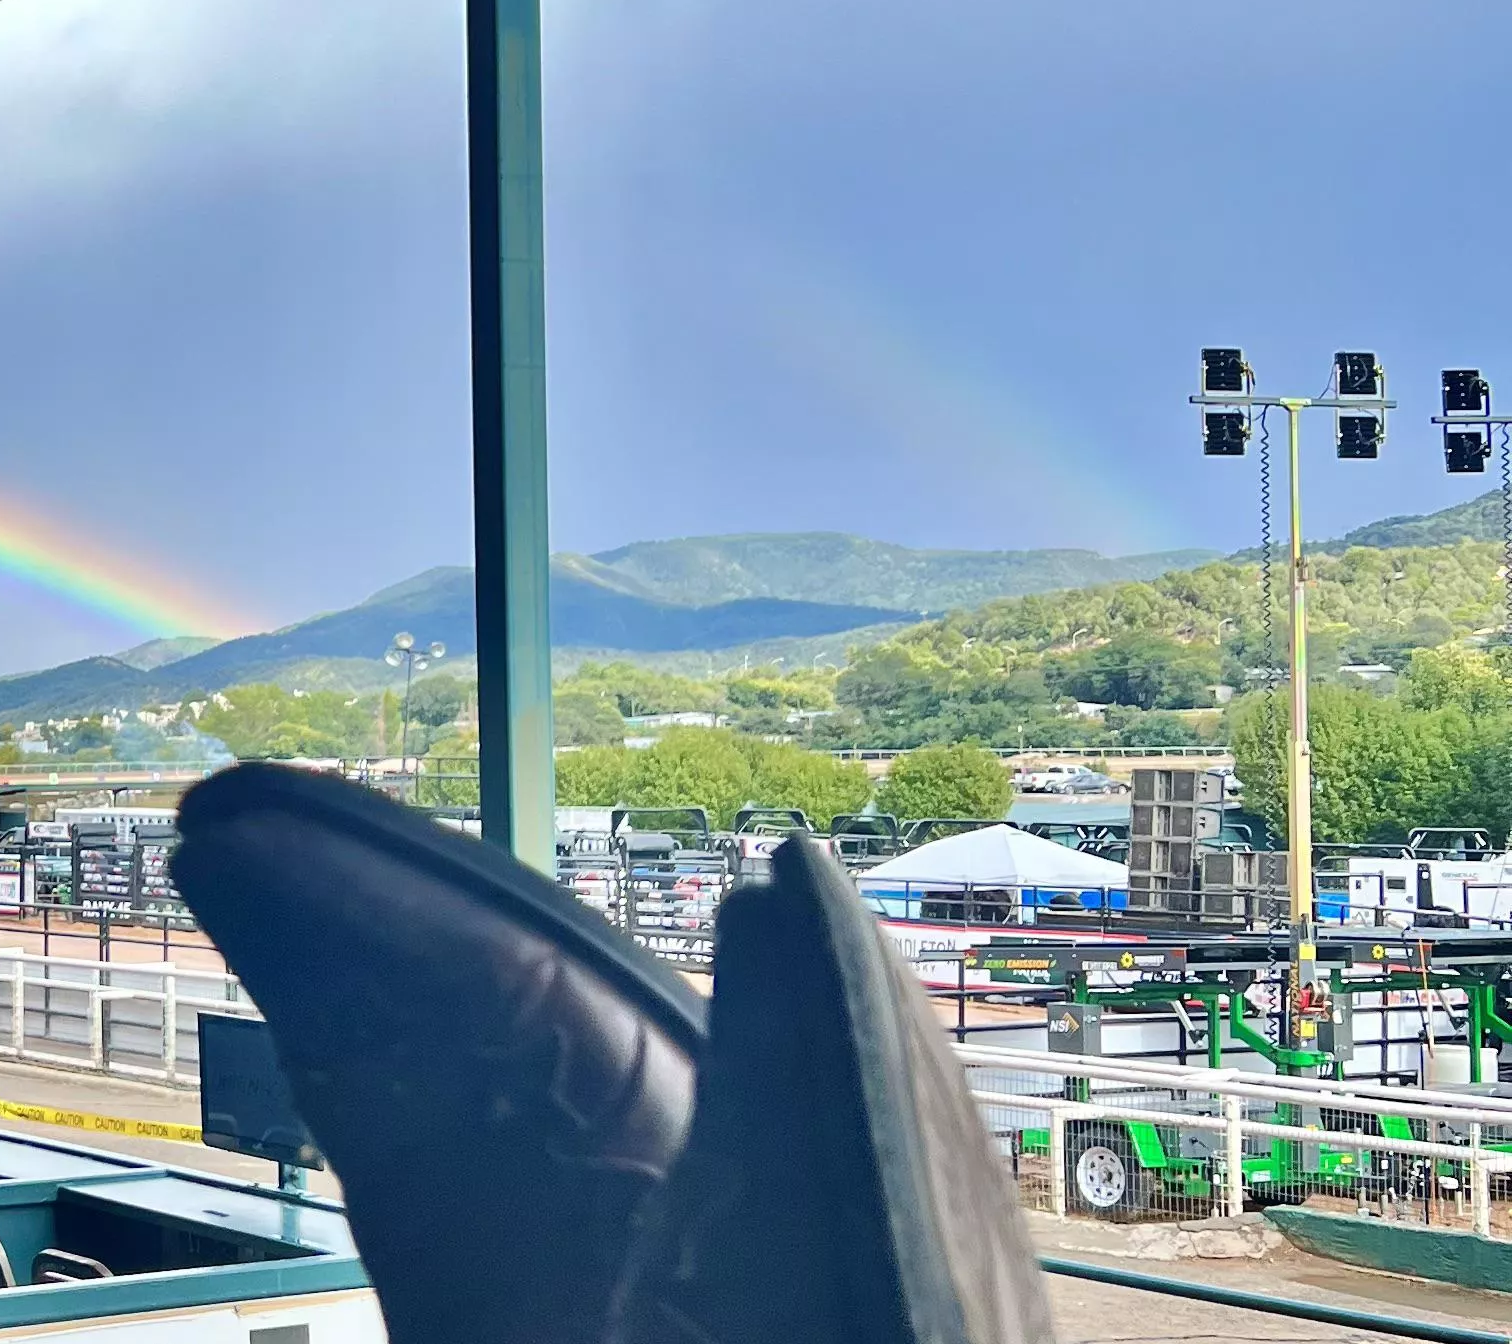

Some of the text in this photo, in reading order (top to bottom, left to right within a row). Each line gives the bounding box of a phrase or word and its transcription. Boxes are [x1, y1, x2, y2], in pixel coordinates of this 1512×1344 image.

[983, 959, 1050, 969] ZERO EMISSION
[1049, 1019, 1070, 1033] NSI
[55, 1112, 84, 1127] CAUTION
[95, 1117, 126, 1133] CAUTION
[136, 1122, 168, 1137] CAUTION
